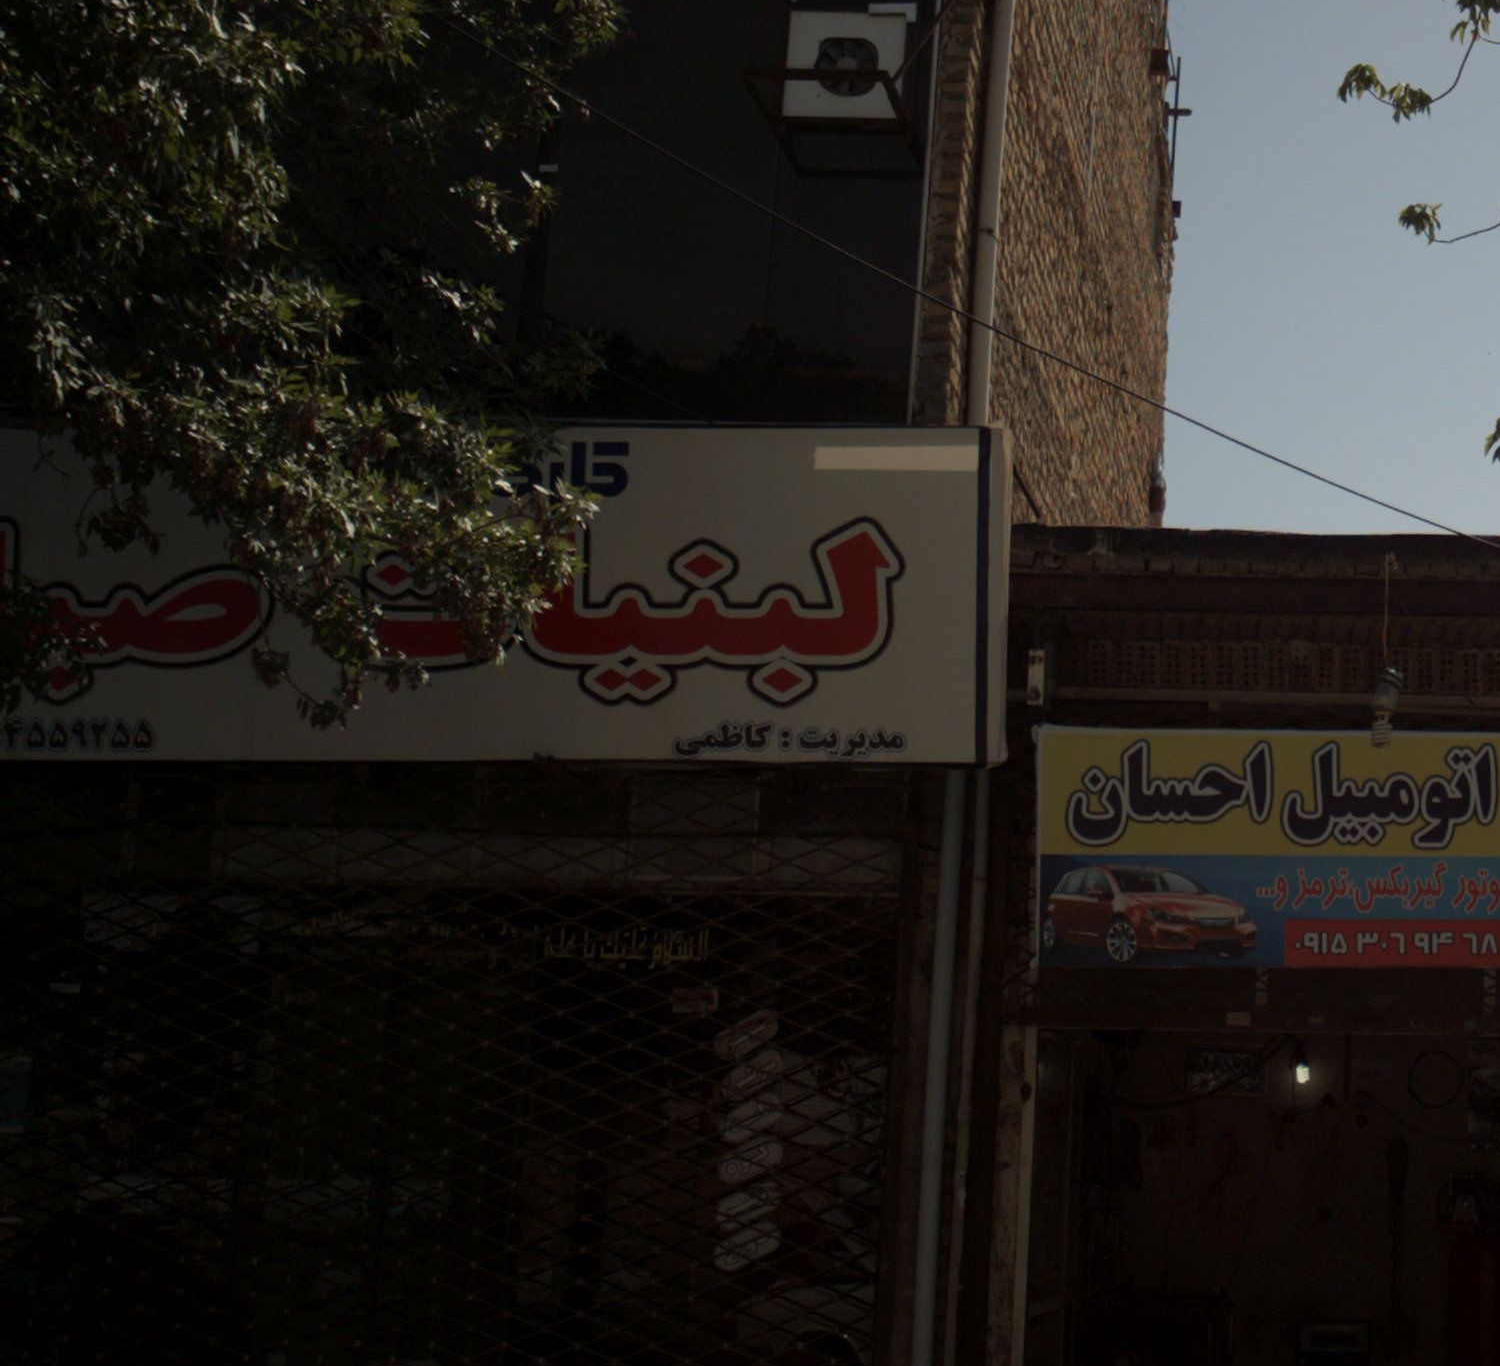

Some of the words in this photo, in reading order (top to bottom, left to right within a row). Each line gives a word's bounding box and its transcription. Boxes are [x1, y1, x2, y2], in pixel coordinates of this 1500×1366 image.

[674, 722, 772, 757] کاظمی
[799, 728, 905, 759] مدیریت
[1066, 738, 1274, 846] احسان
[1283, 740, 1498, 849] اتومبیل
